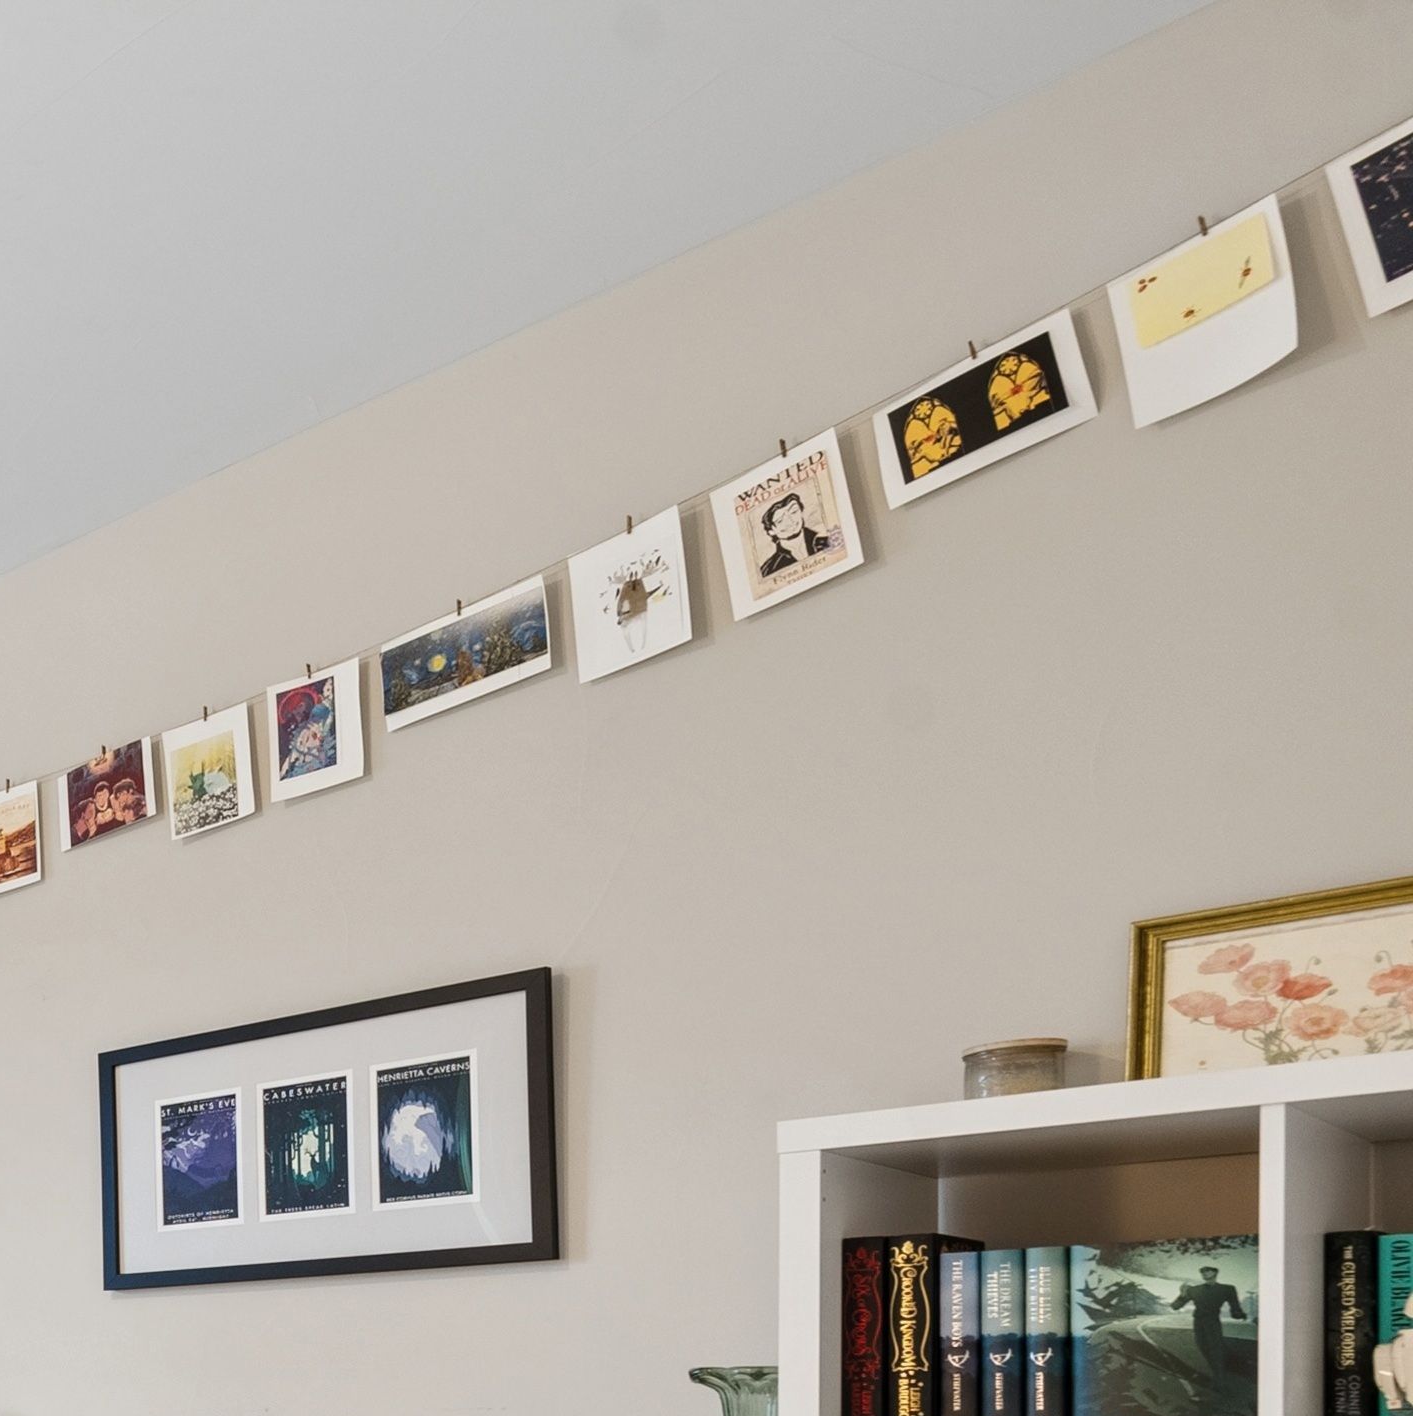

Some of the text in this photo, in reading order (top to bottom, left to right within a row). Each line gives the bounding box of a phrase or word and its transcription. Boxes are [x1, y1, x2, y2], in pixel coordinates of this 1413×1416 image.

[735, 460, 828, 516] DEAD ALIVE
[738, 450, 824, 501] WANTED
[262, 1080, 348, 1102] CABESWATER
[376, 1061, 471, 1084] HENRIETTA CAVERNS
[161, 1098, 237, 1118] ST. MARK'S EVE
[1390, 1240, 1412, 1283] OLIVIE
[899, 1267, 917, 1371] CROOKED KINGDOM
[951, 1260, 963, 1348] THE RAVEN BOYS
[987, 1263, 1012, 1328] THE DREAM THIEVES
[1337, 1262, 1359, 1367] CURSED MELODIES
